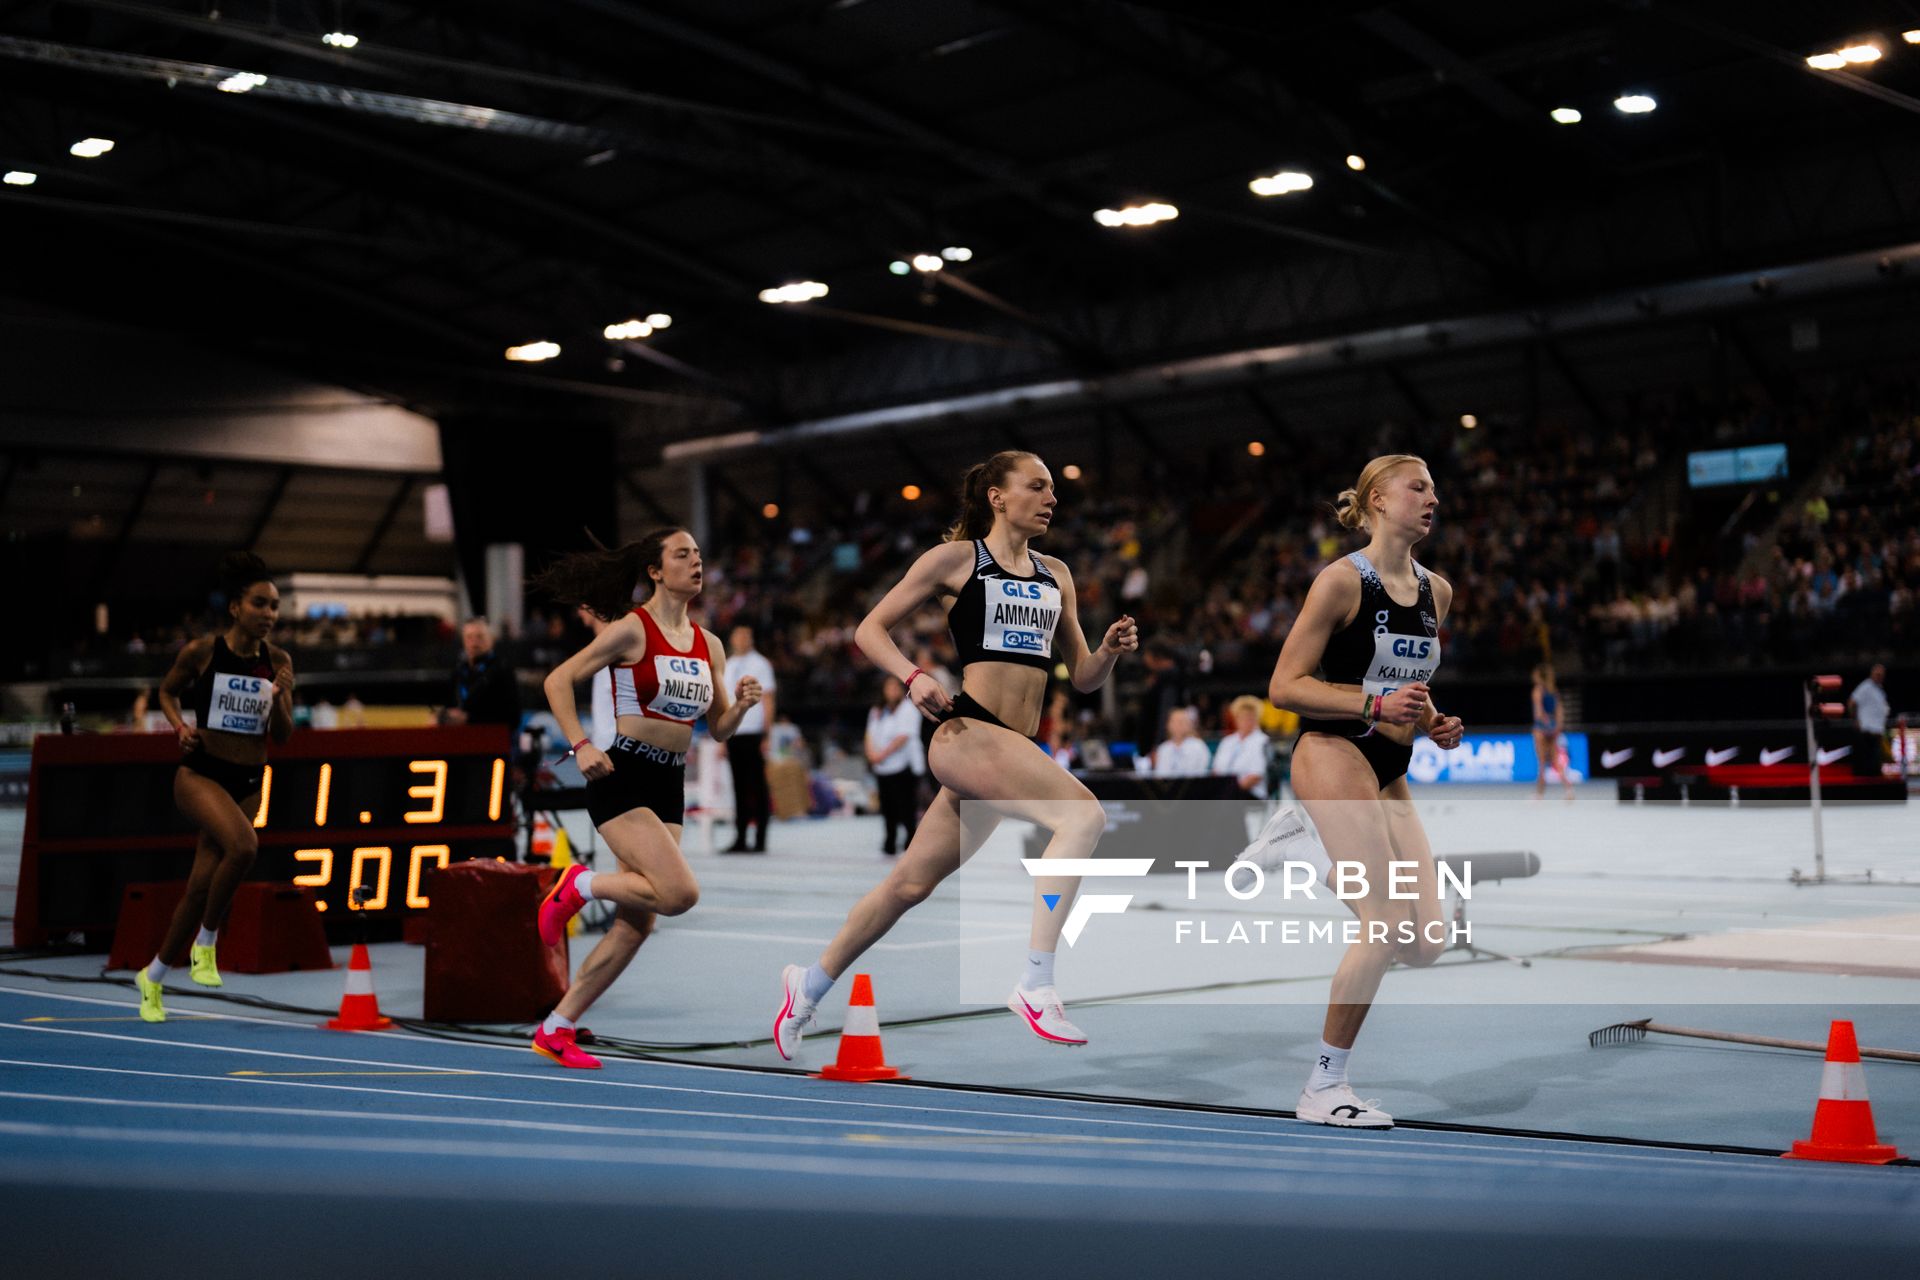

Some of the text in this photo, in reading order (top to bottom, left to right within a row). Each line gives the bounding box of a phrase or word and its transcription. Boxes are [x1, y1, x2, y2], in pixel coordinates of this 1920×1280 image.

[1002, 581, 1042, 600] GLS
[993, 602, 1057, 631] AMMANN
[1392, 638, 1431, 659] GLS
[670, 659, 699, 676] GLS
[228, 678, 261, 693] GLS
[664, 679, 710, 703] MILETIC
[634, 743, 670, 764] PRO
